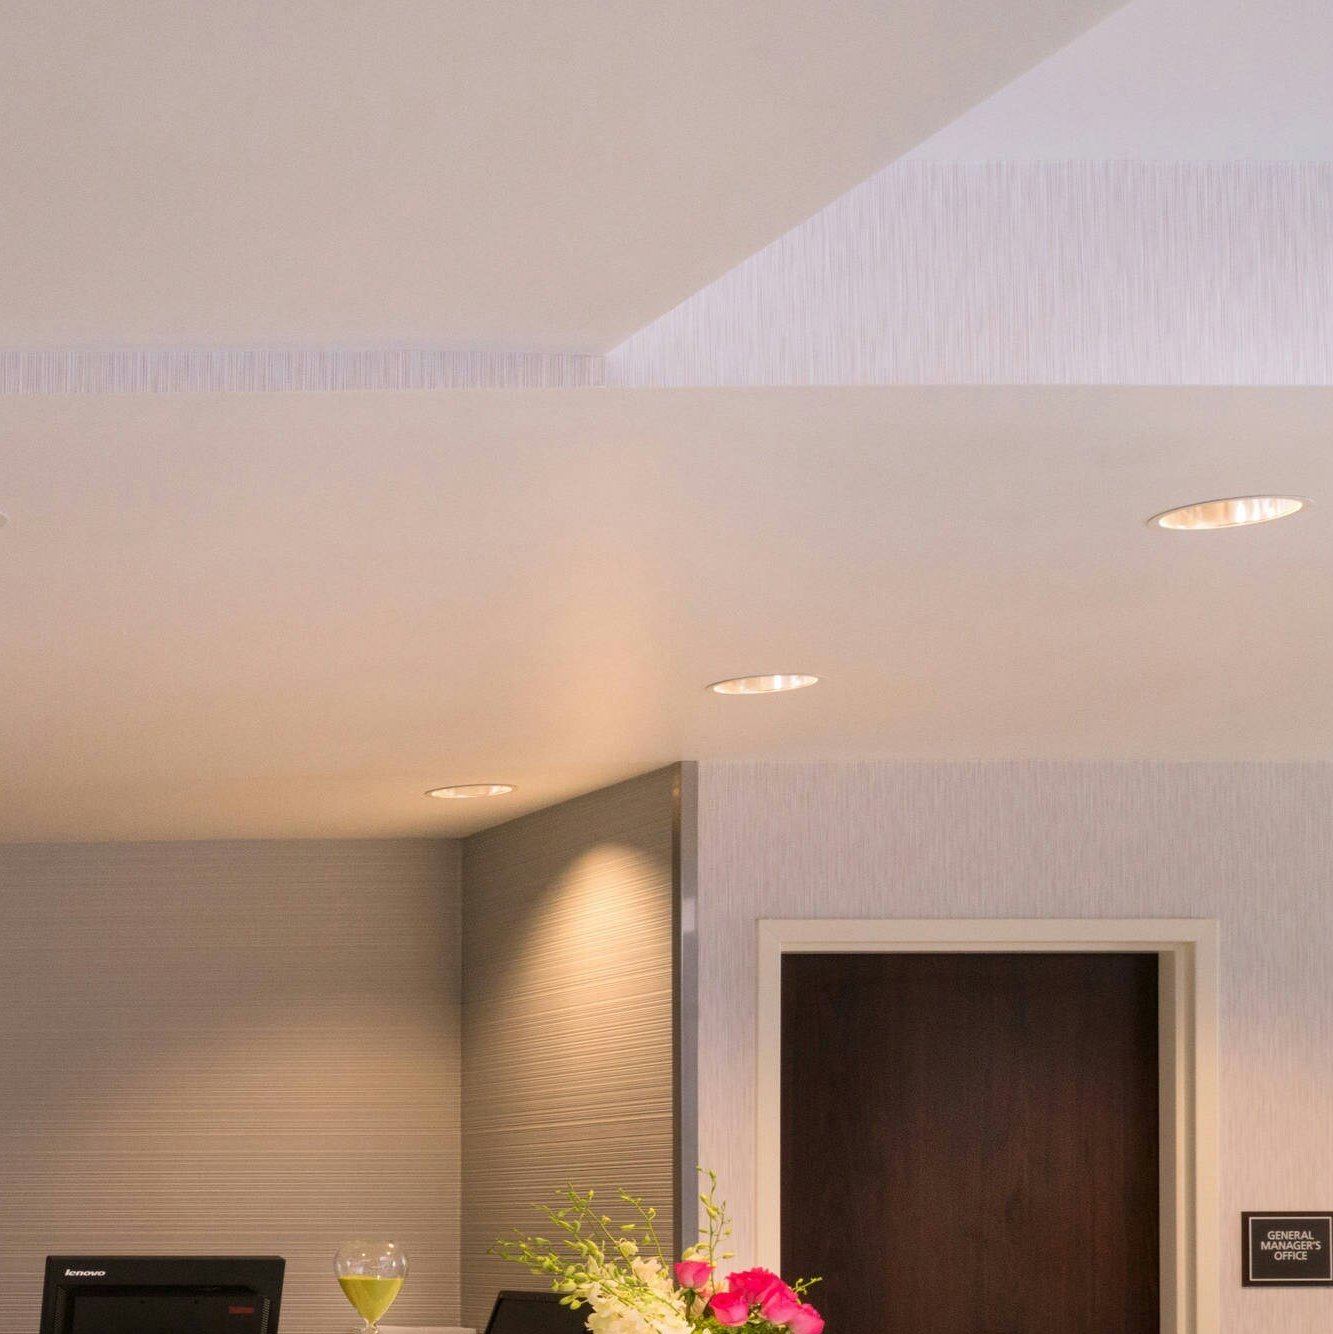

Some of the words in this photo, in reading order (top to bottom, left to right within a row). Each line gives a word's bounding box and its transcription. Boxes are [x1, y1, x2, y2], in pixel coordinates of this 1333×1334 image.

[1267, 1230, 1315, 1240] GENERAL
[1260, 1241, 1322, 1250] MANAGER'S
[1273, 1251, 1308, 1260] OFFICE
[64, 1268, 107, 1277] lenovo
